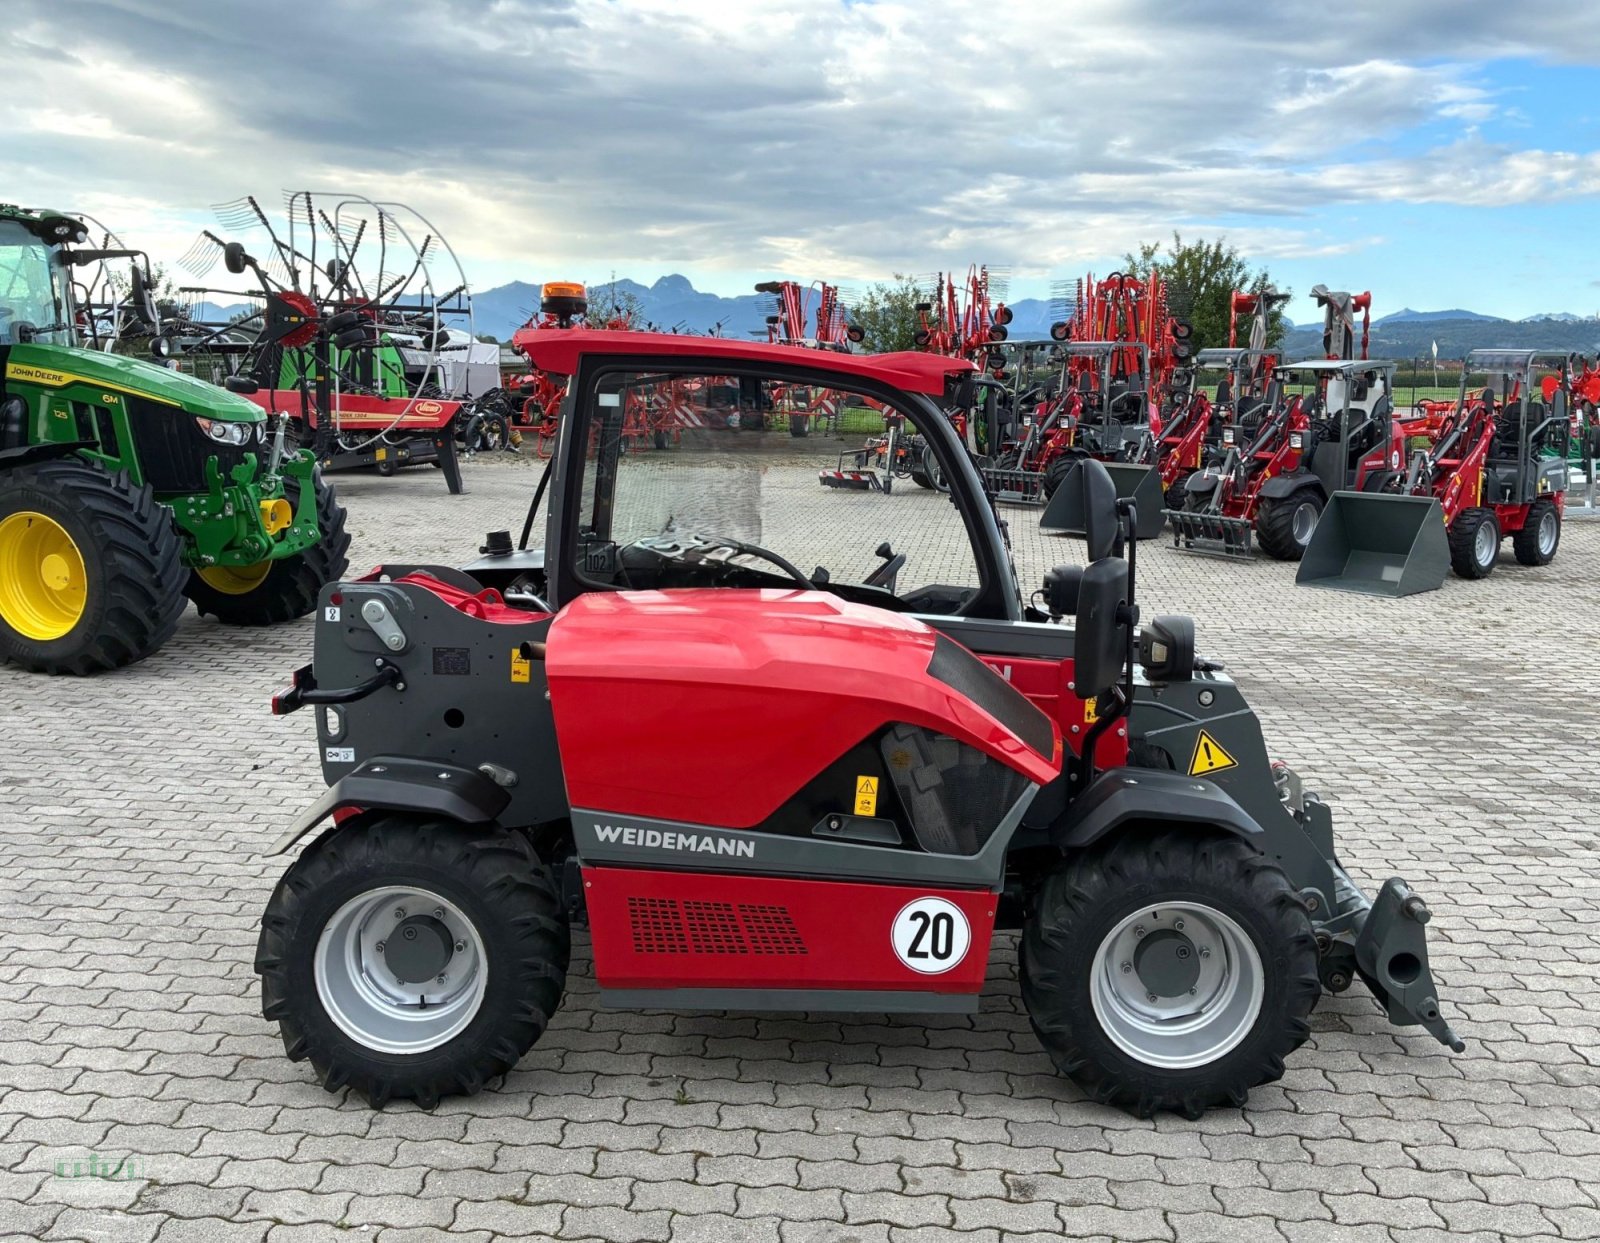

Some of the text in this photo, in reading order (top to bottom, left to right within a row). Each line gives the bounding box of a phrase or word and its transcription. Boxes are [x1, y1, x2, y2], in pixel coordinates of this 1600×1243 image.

[11, 367, 64, 382] JOHN DEERE
[102, 394, 119, 404] 6M
[588, 554, 606, 570] 102
[594, 824, 755, 858] WEIDEMANN
[907, 910, 954, 961] 20
